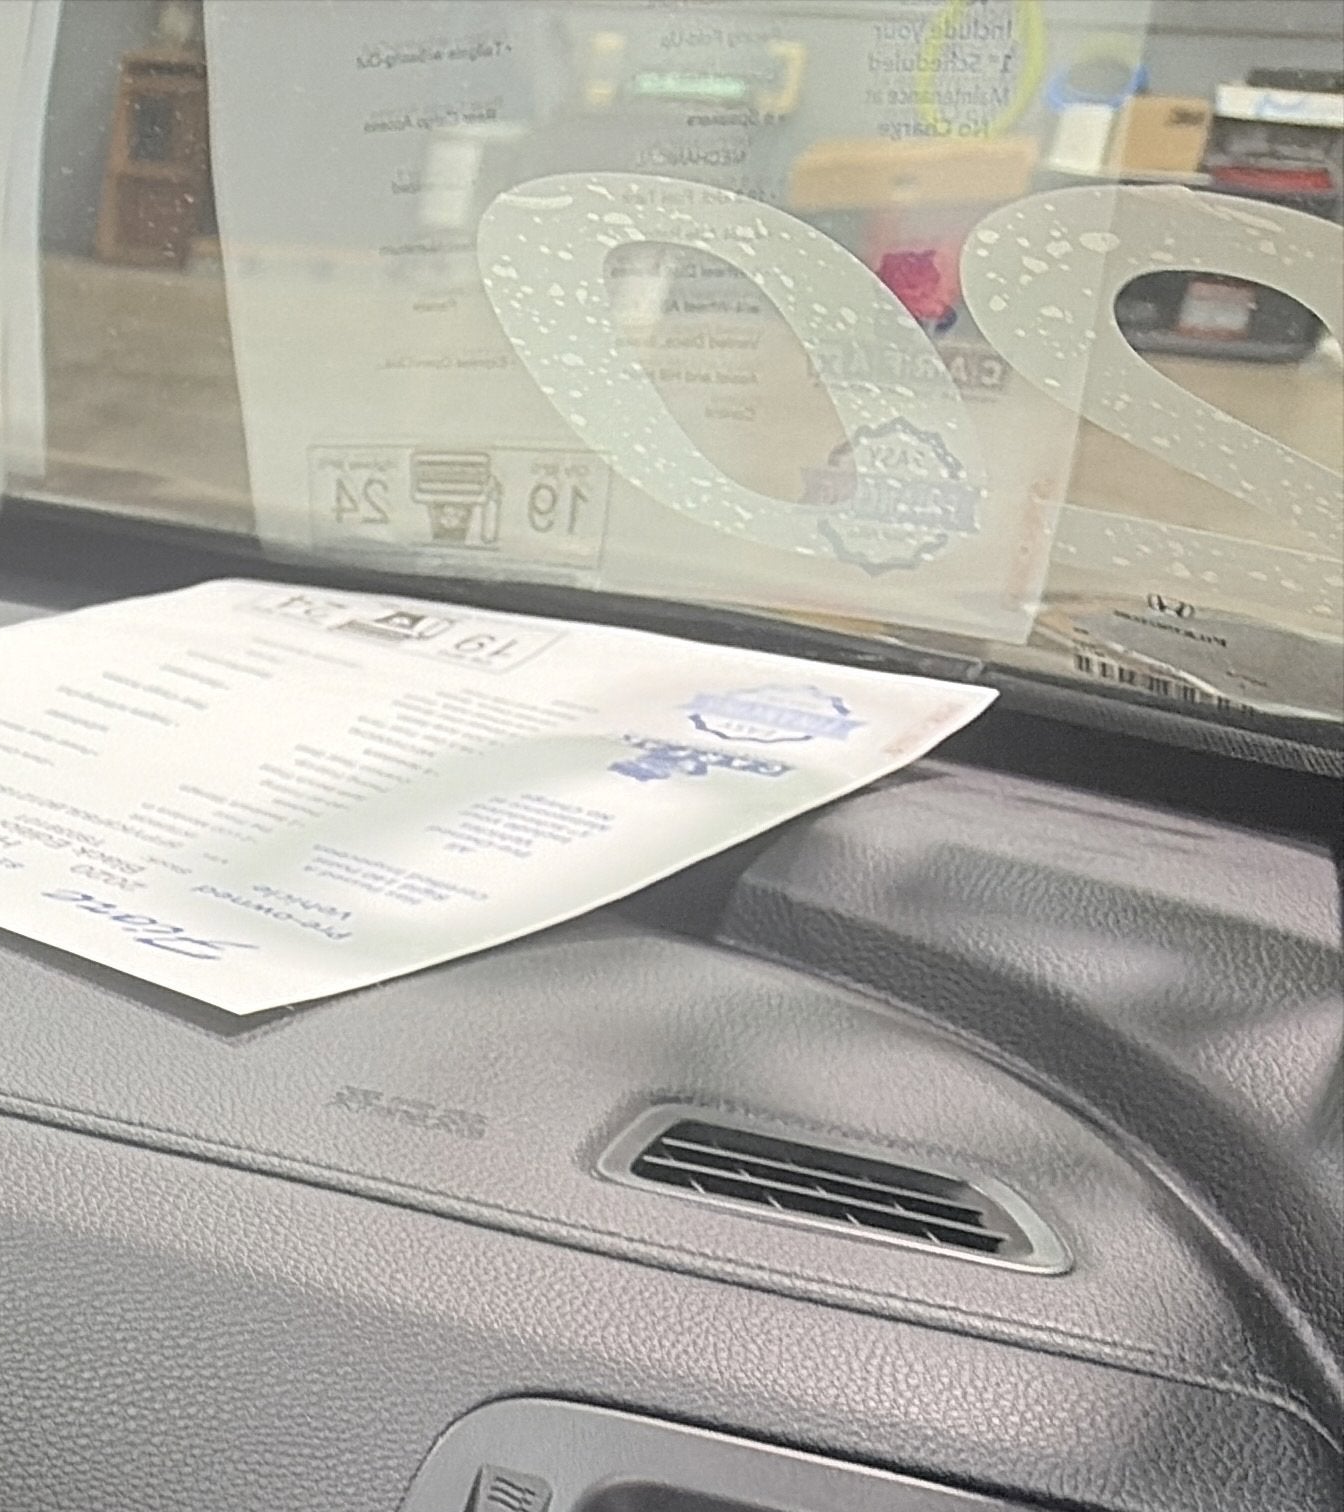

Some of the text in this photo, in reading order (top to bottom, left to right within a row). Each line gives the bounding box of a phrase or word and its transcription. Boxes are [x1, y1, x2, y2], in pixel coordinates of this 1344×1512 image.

[455, 633, 519, 661] 19
[72, 846, 146, 875] Black
[70, 864, 147, 892] 2020
